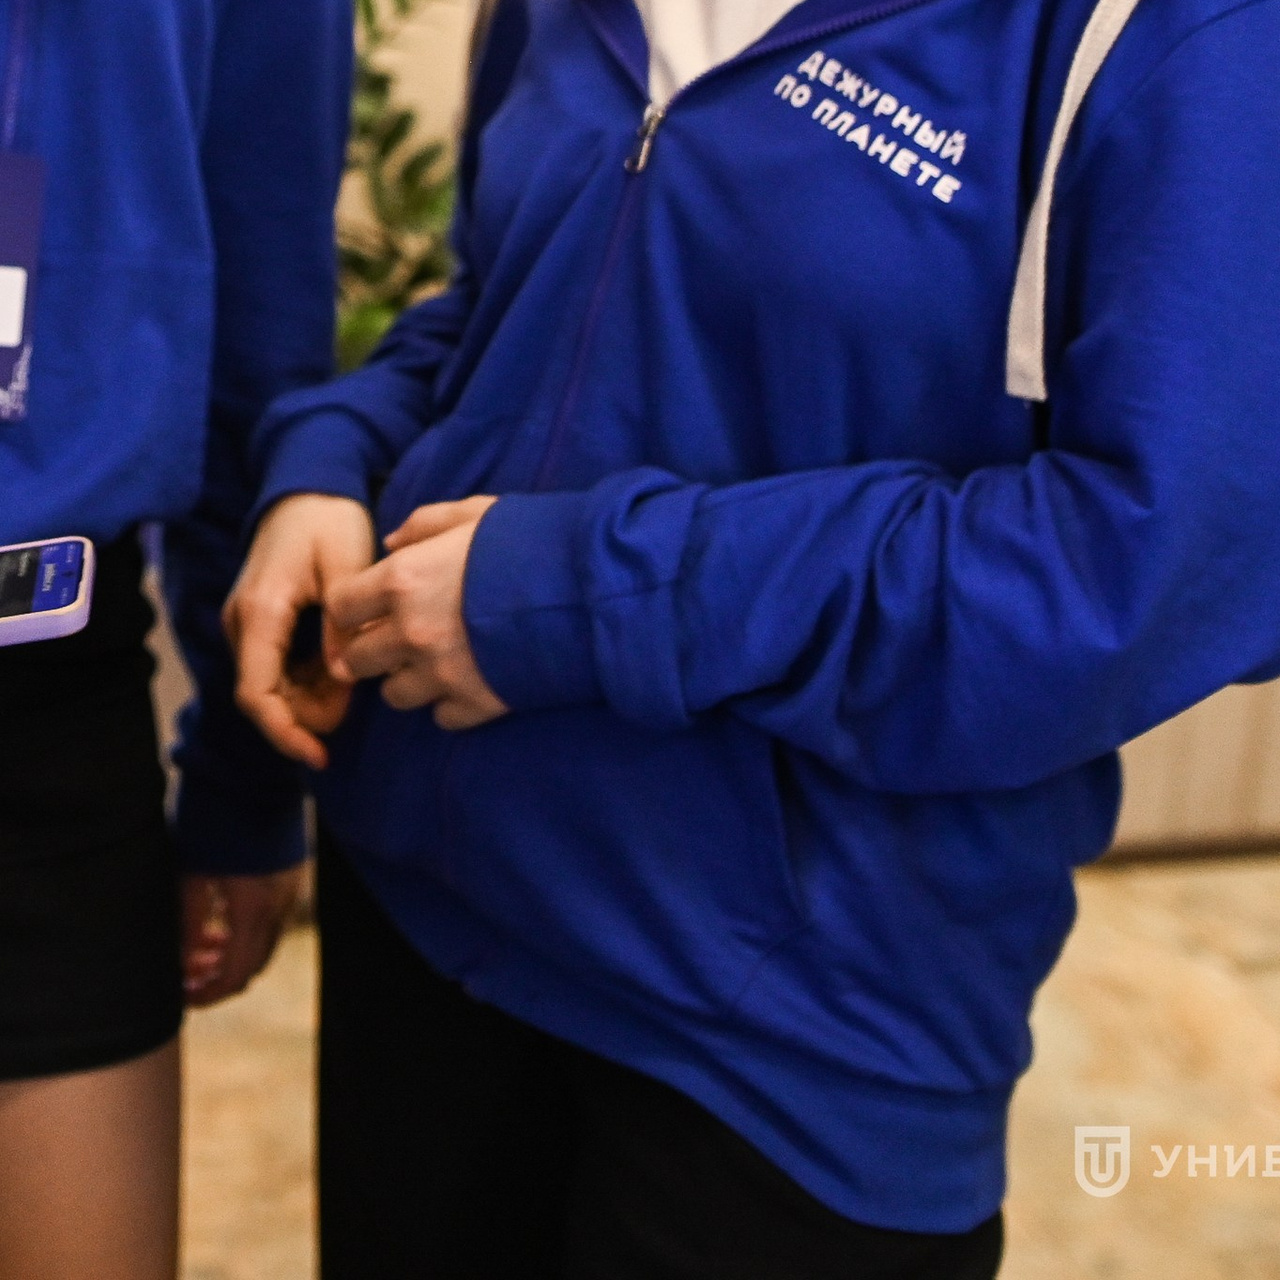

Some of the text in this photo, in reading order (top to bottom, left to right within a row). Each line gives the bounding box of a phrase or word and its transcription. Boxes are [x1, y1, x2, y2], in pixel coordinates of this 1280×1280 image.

[773, 73, 962, 203] ПО ПЛАНЕТЕ
[797, 50, 967, 166] ДЕЖУРНЫЙ
